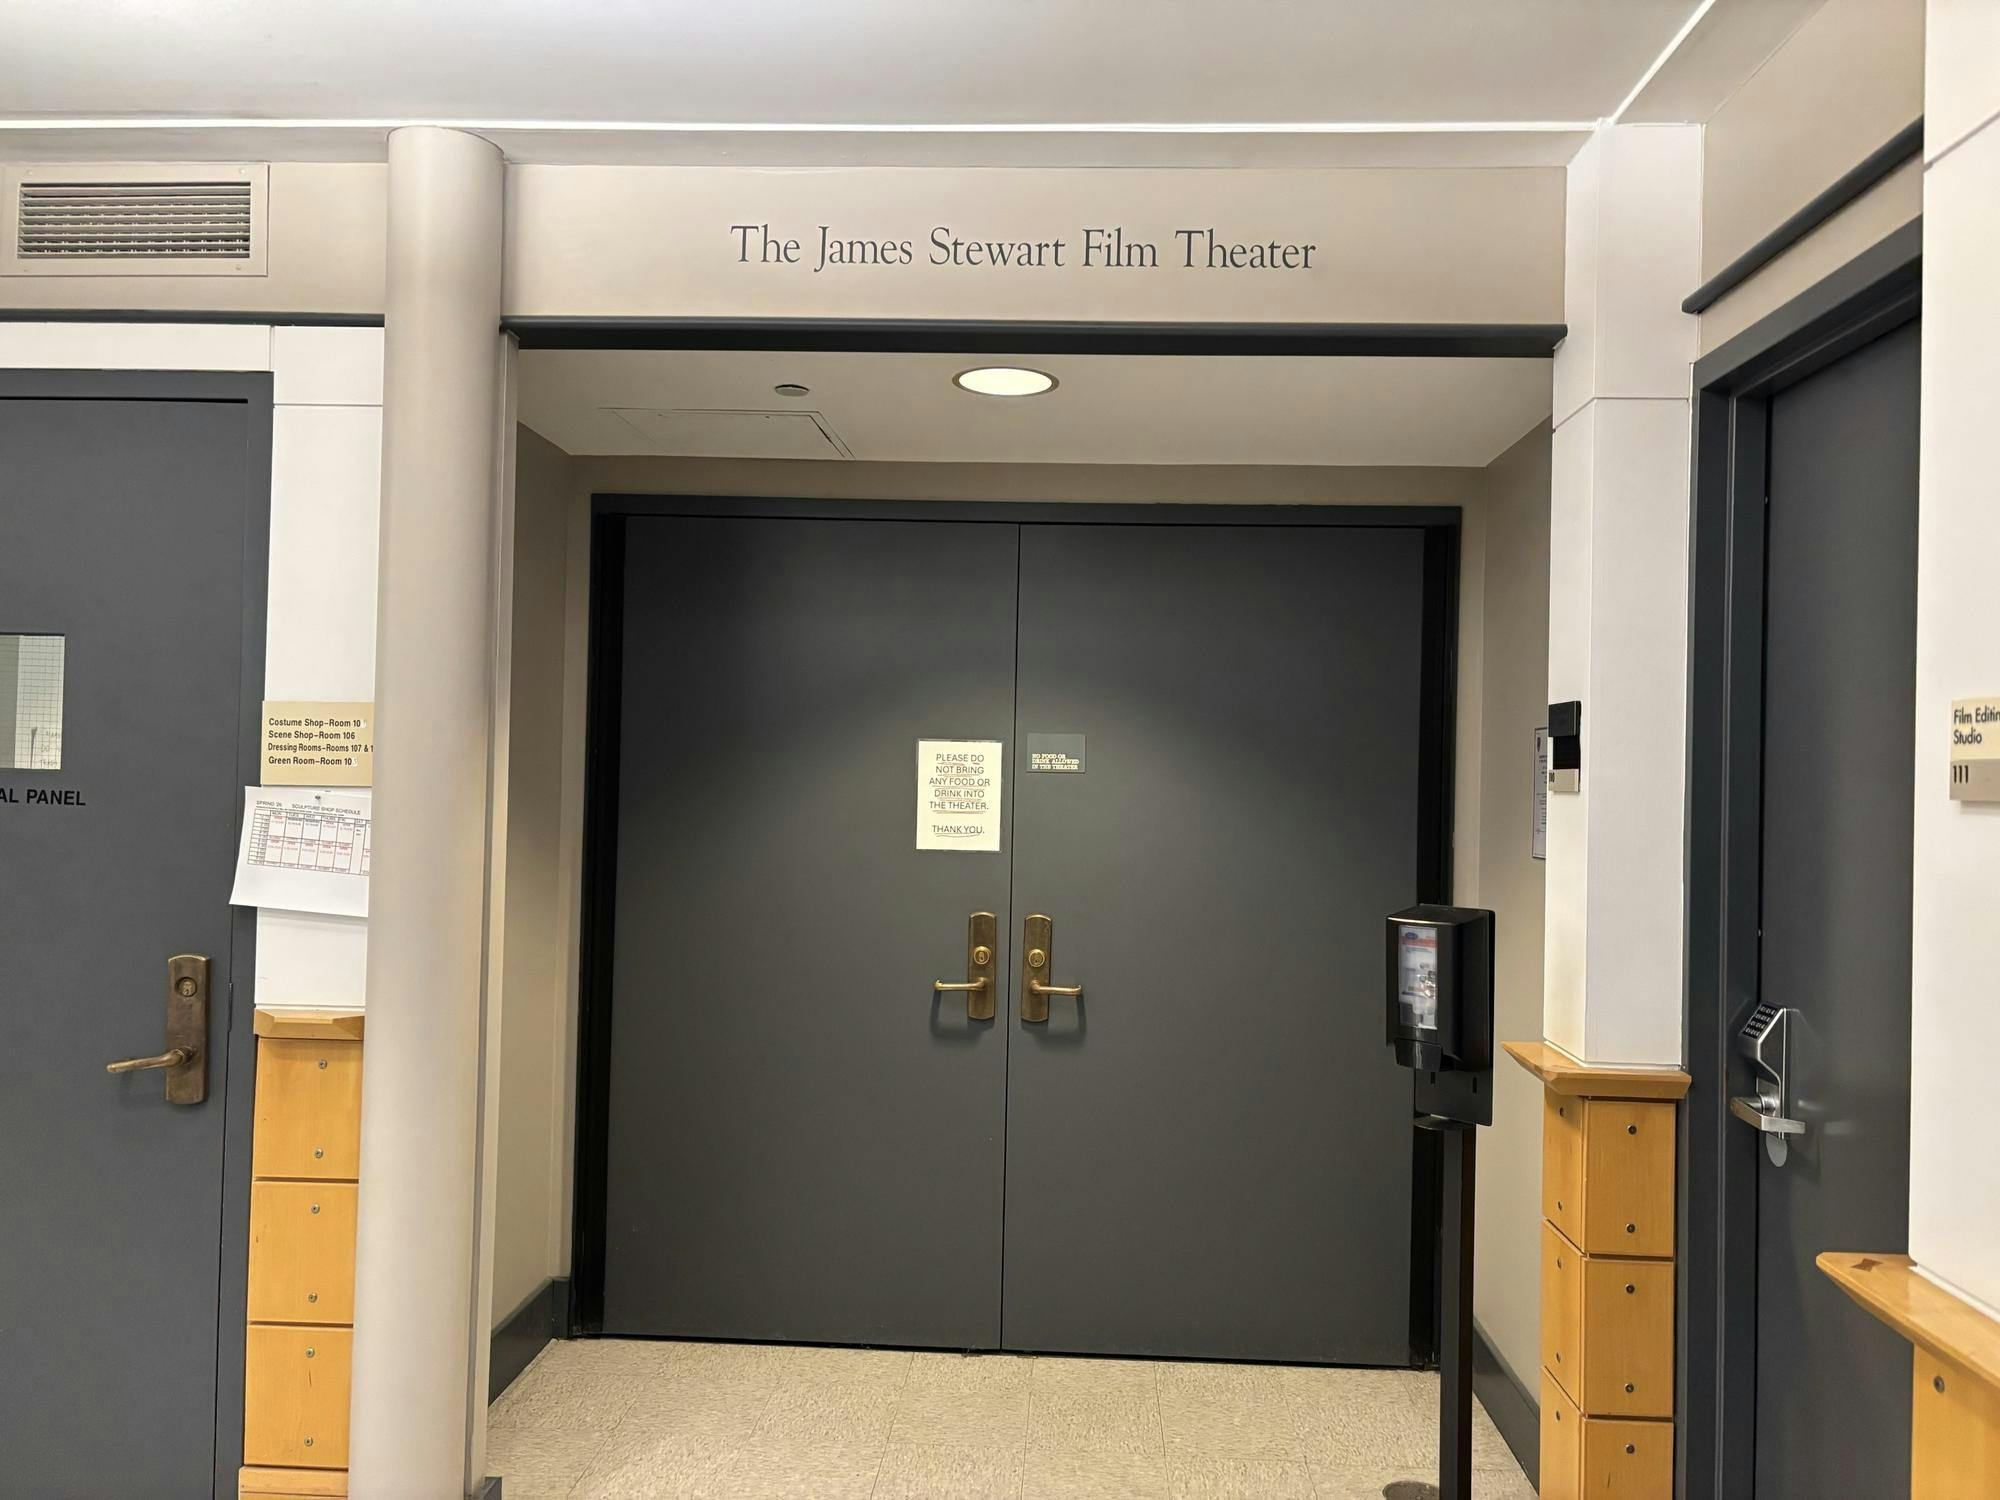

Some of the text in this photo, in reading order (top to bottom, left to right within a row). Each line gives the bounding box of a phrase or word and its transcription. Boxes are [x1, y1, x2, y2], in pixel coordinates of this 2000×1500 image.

[730, 225, 1317, 273] The James Stewart Film Theater
[1953, 705, 2000, 725] Film Editin
[268, 717, 303, 727] Costume
[268, 730, 292, 739] Scene
[343, 731, 356, 740] 106
[1953, 727, 1983, 745] Studio
[268, 742, 297, 753] Dressing
[351, 744, 362, 752] 107
[363, 744, 369, 753] &
[370, 744, 374, 753] 1
[268, 755, 291, 765] Green
[936, 753, 985, 763] PLEASE DO
[935, 765, 985, 775] NOT BRING
[928, 777, 991, 787] ANY FOOD OR
[0, 787, 86, 806] AL PANEL
[934, 789, 985, 798] DRINK INTO
[292, 803, 320, 811] SCULPTURE
[335, 807, 361, 816] SCHEDULE
[929, 801, 989, 810] THE THEATER.
[931, 825, 985, 835] THANK YOU.
